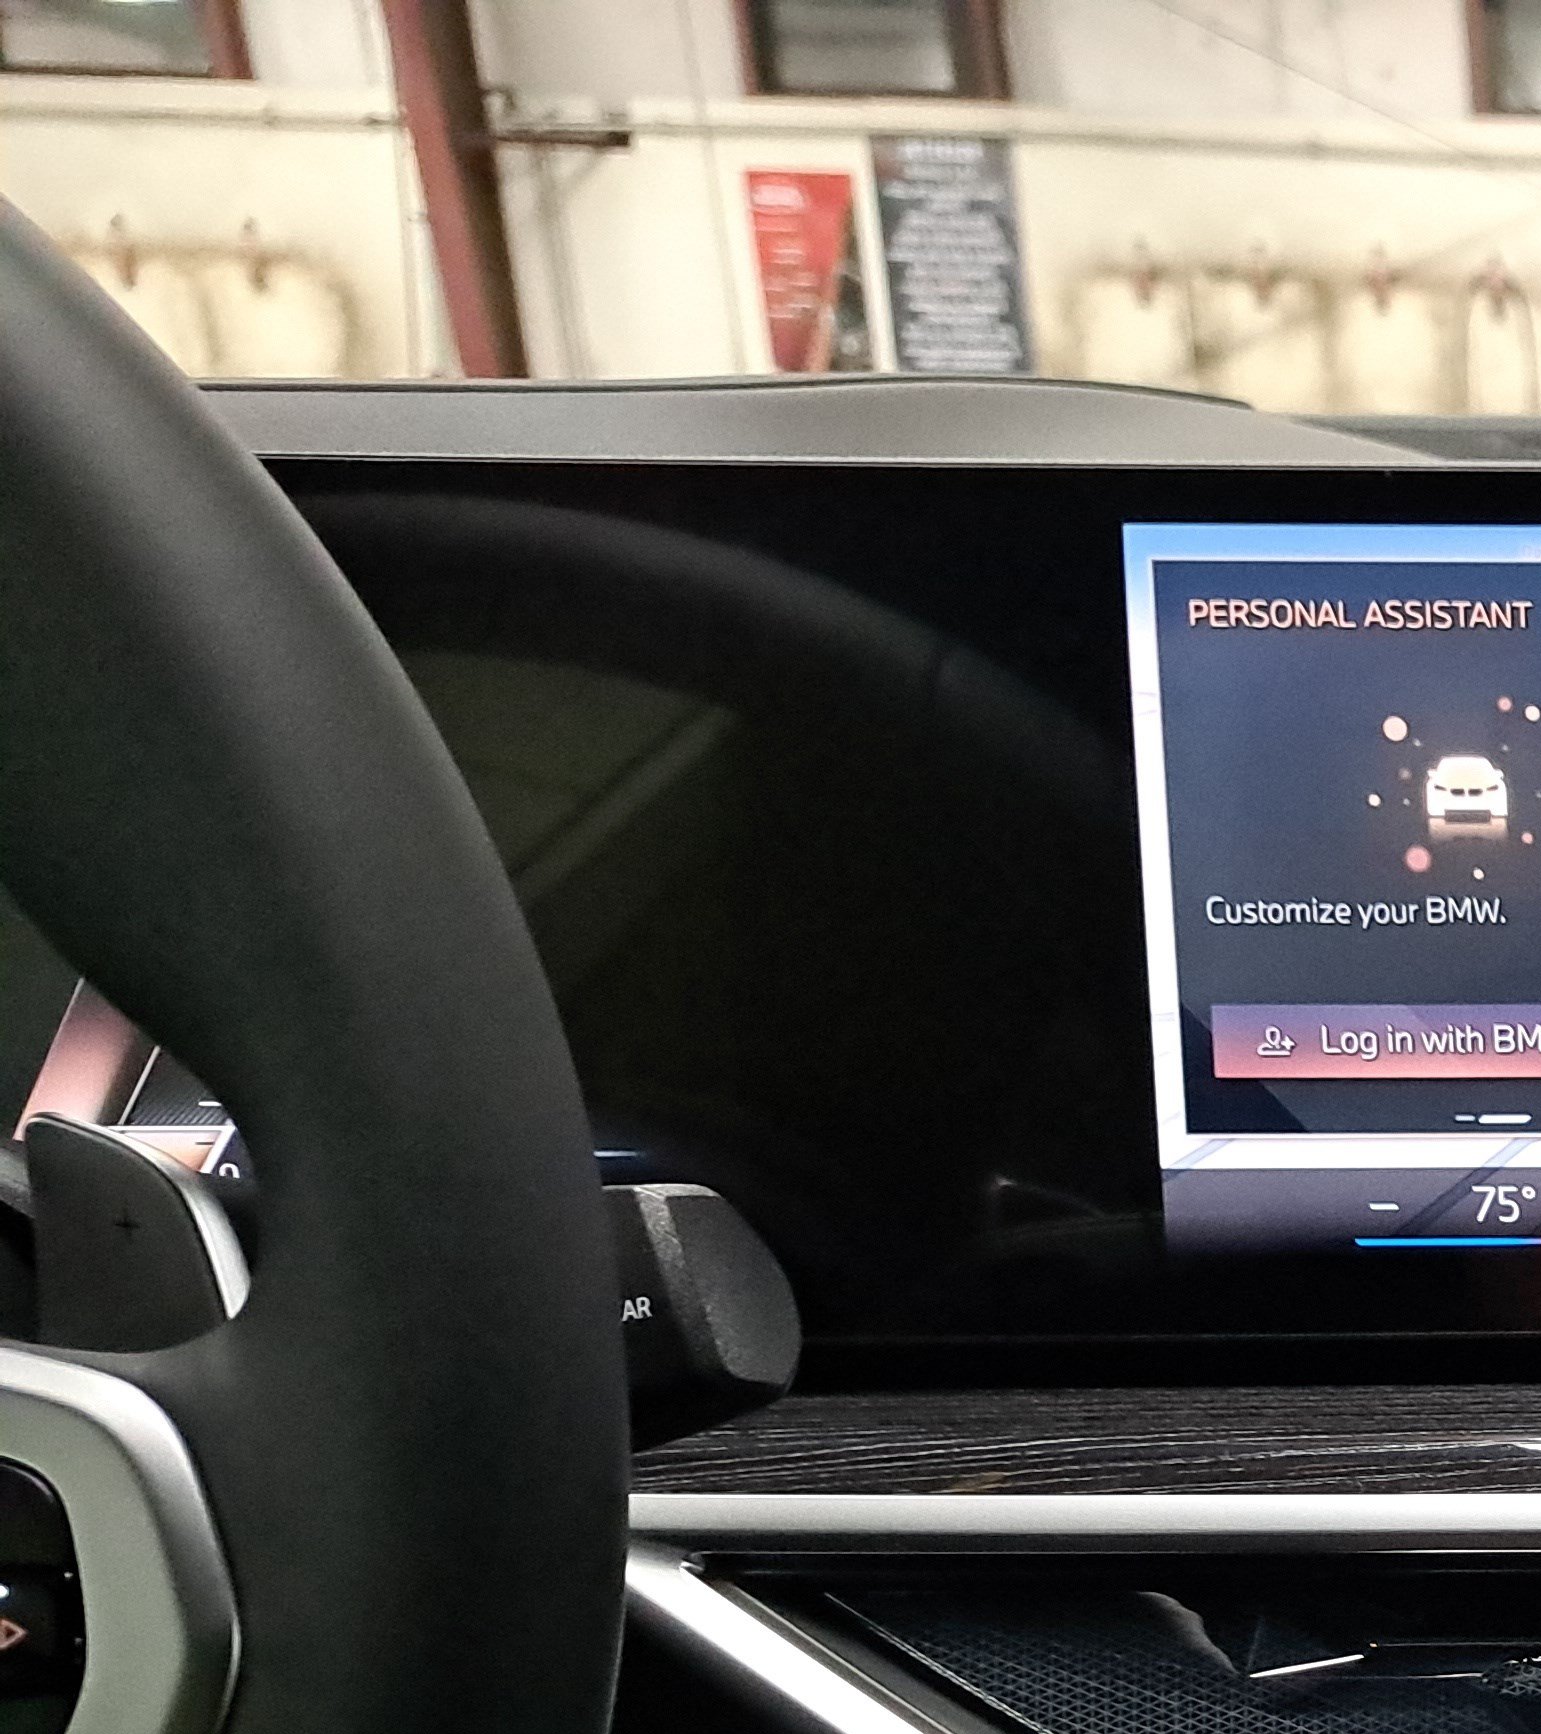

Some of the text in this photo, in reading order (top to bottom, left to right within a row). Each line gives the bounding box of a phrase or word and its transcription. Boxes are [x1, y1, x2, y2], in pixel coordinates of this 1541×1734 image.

[1188, 599, 1534, 629] PERSONAL ASSISTANT
[1205, 895, 1507, 930] Customize your BMW.
[1321, 1024, 1379, 1061] Log
[1387, 1024, 1415, 1054] in
[1421, 1023, 1485, 1054] with
[1471, 1185, 1537, 1223] 75°
